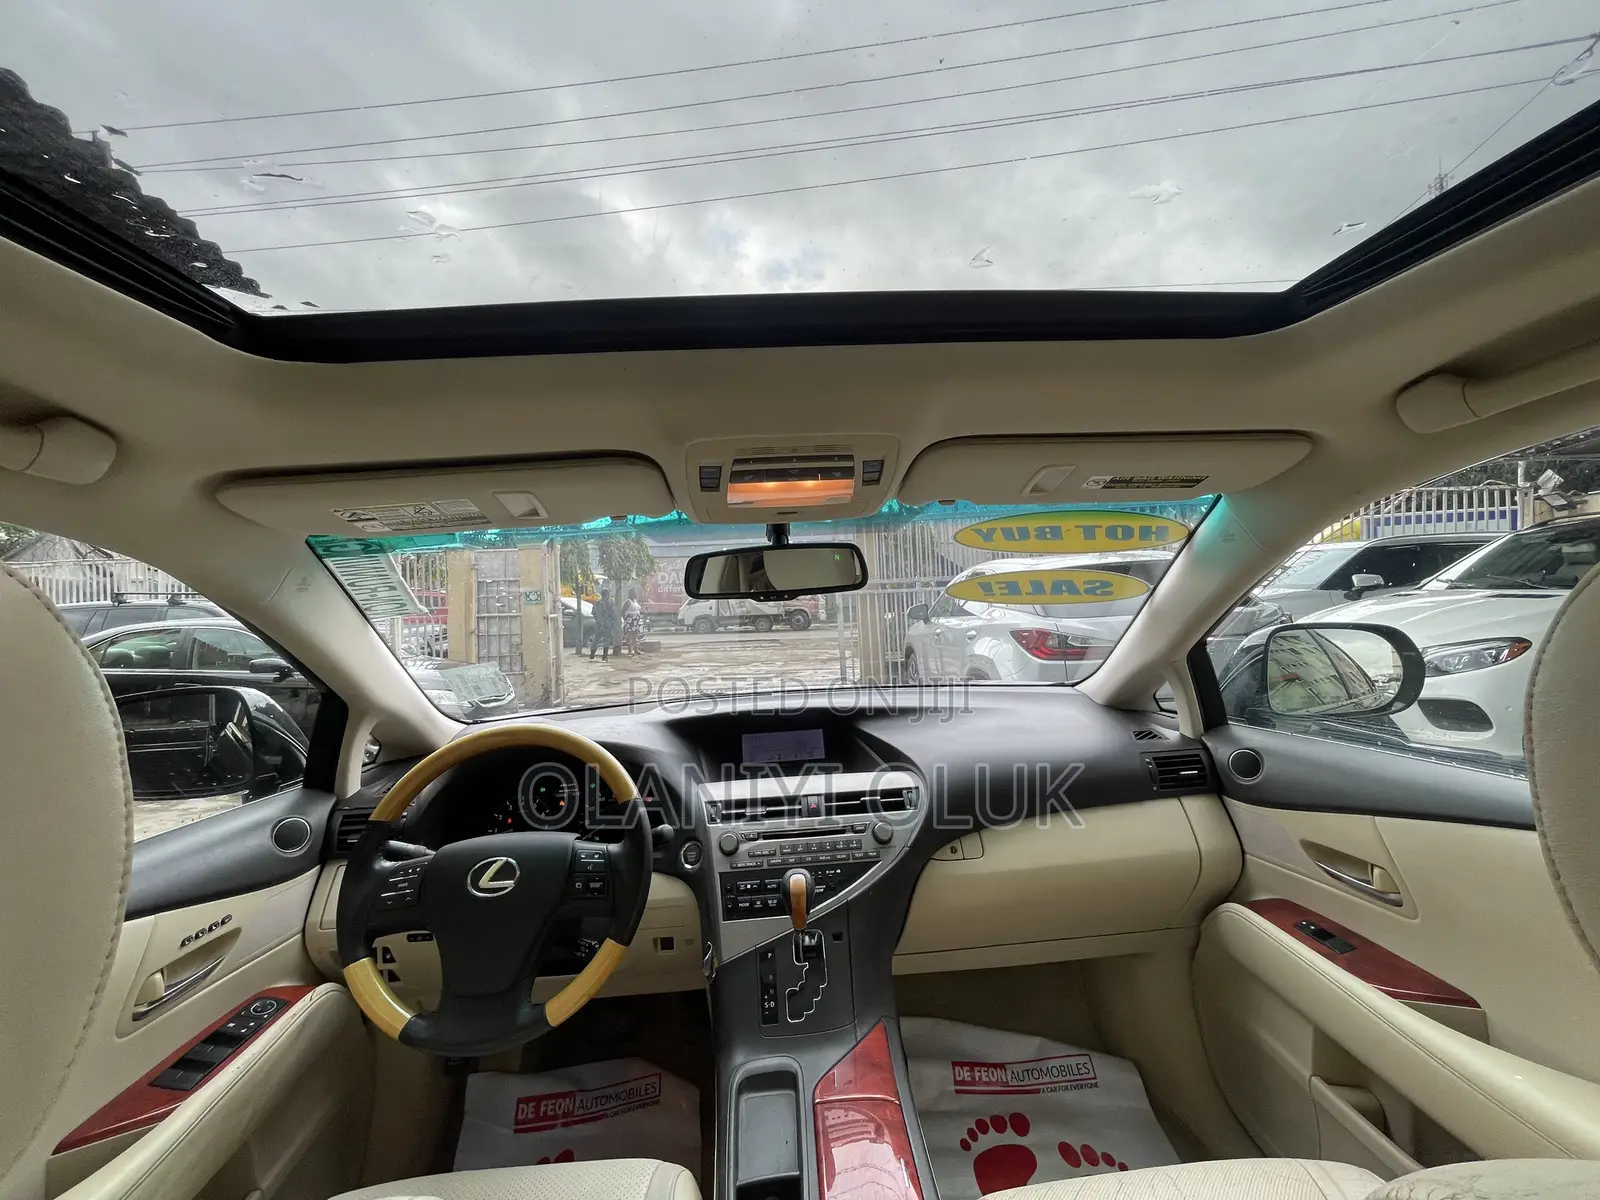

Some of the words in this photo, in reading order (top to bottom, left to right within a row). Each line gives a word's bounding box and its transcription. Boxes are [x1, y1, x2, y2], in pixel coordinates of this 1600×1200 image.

[954, 1066, 971, 1081] DE
[974, 1066, 1007, 1082] FEON
[1010, 1061, 1091, 1083] AUTOMOBILES
[1070, 1081, 1100, 1091] EVERYONE
[517, 1101, 536, 1120] DE
[540, 1096, 575, 1117] FEON
[576, 1081, 657, 1112] AUTOMOBILES
